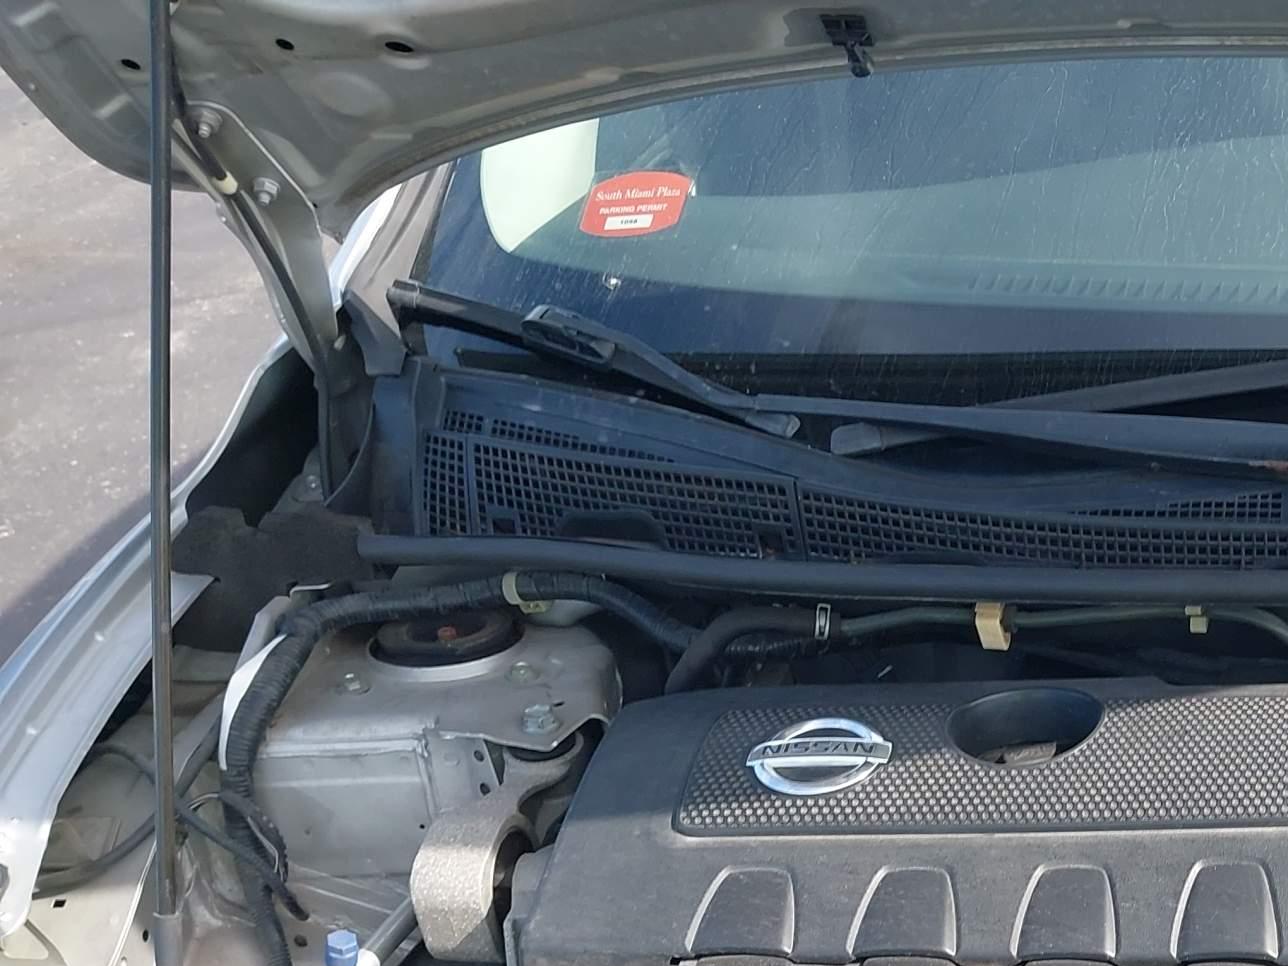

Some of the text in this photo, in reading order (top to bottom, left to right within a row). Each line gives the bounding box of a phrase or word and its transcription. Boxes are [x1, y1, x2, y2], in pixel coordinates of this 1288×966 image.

[596, 185, 681, 201] South Miami Plaza
[599, 203, 668, 215] PARKING PERMIT
[762, 741, 875, 755] NISSAN
